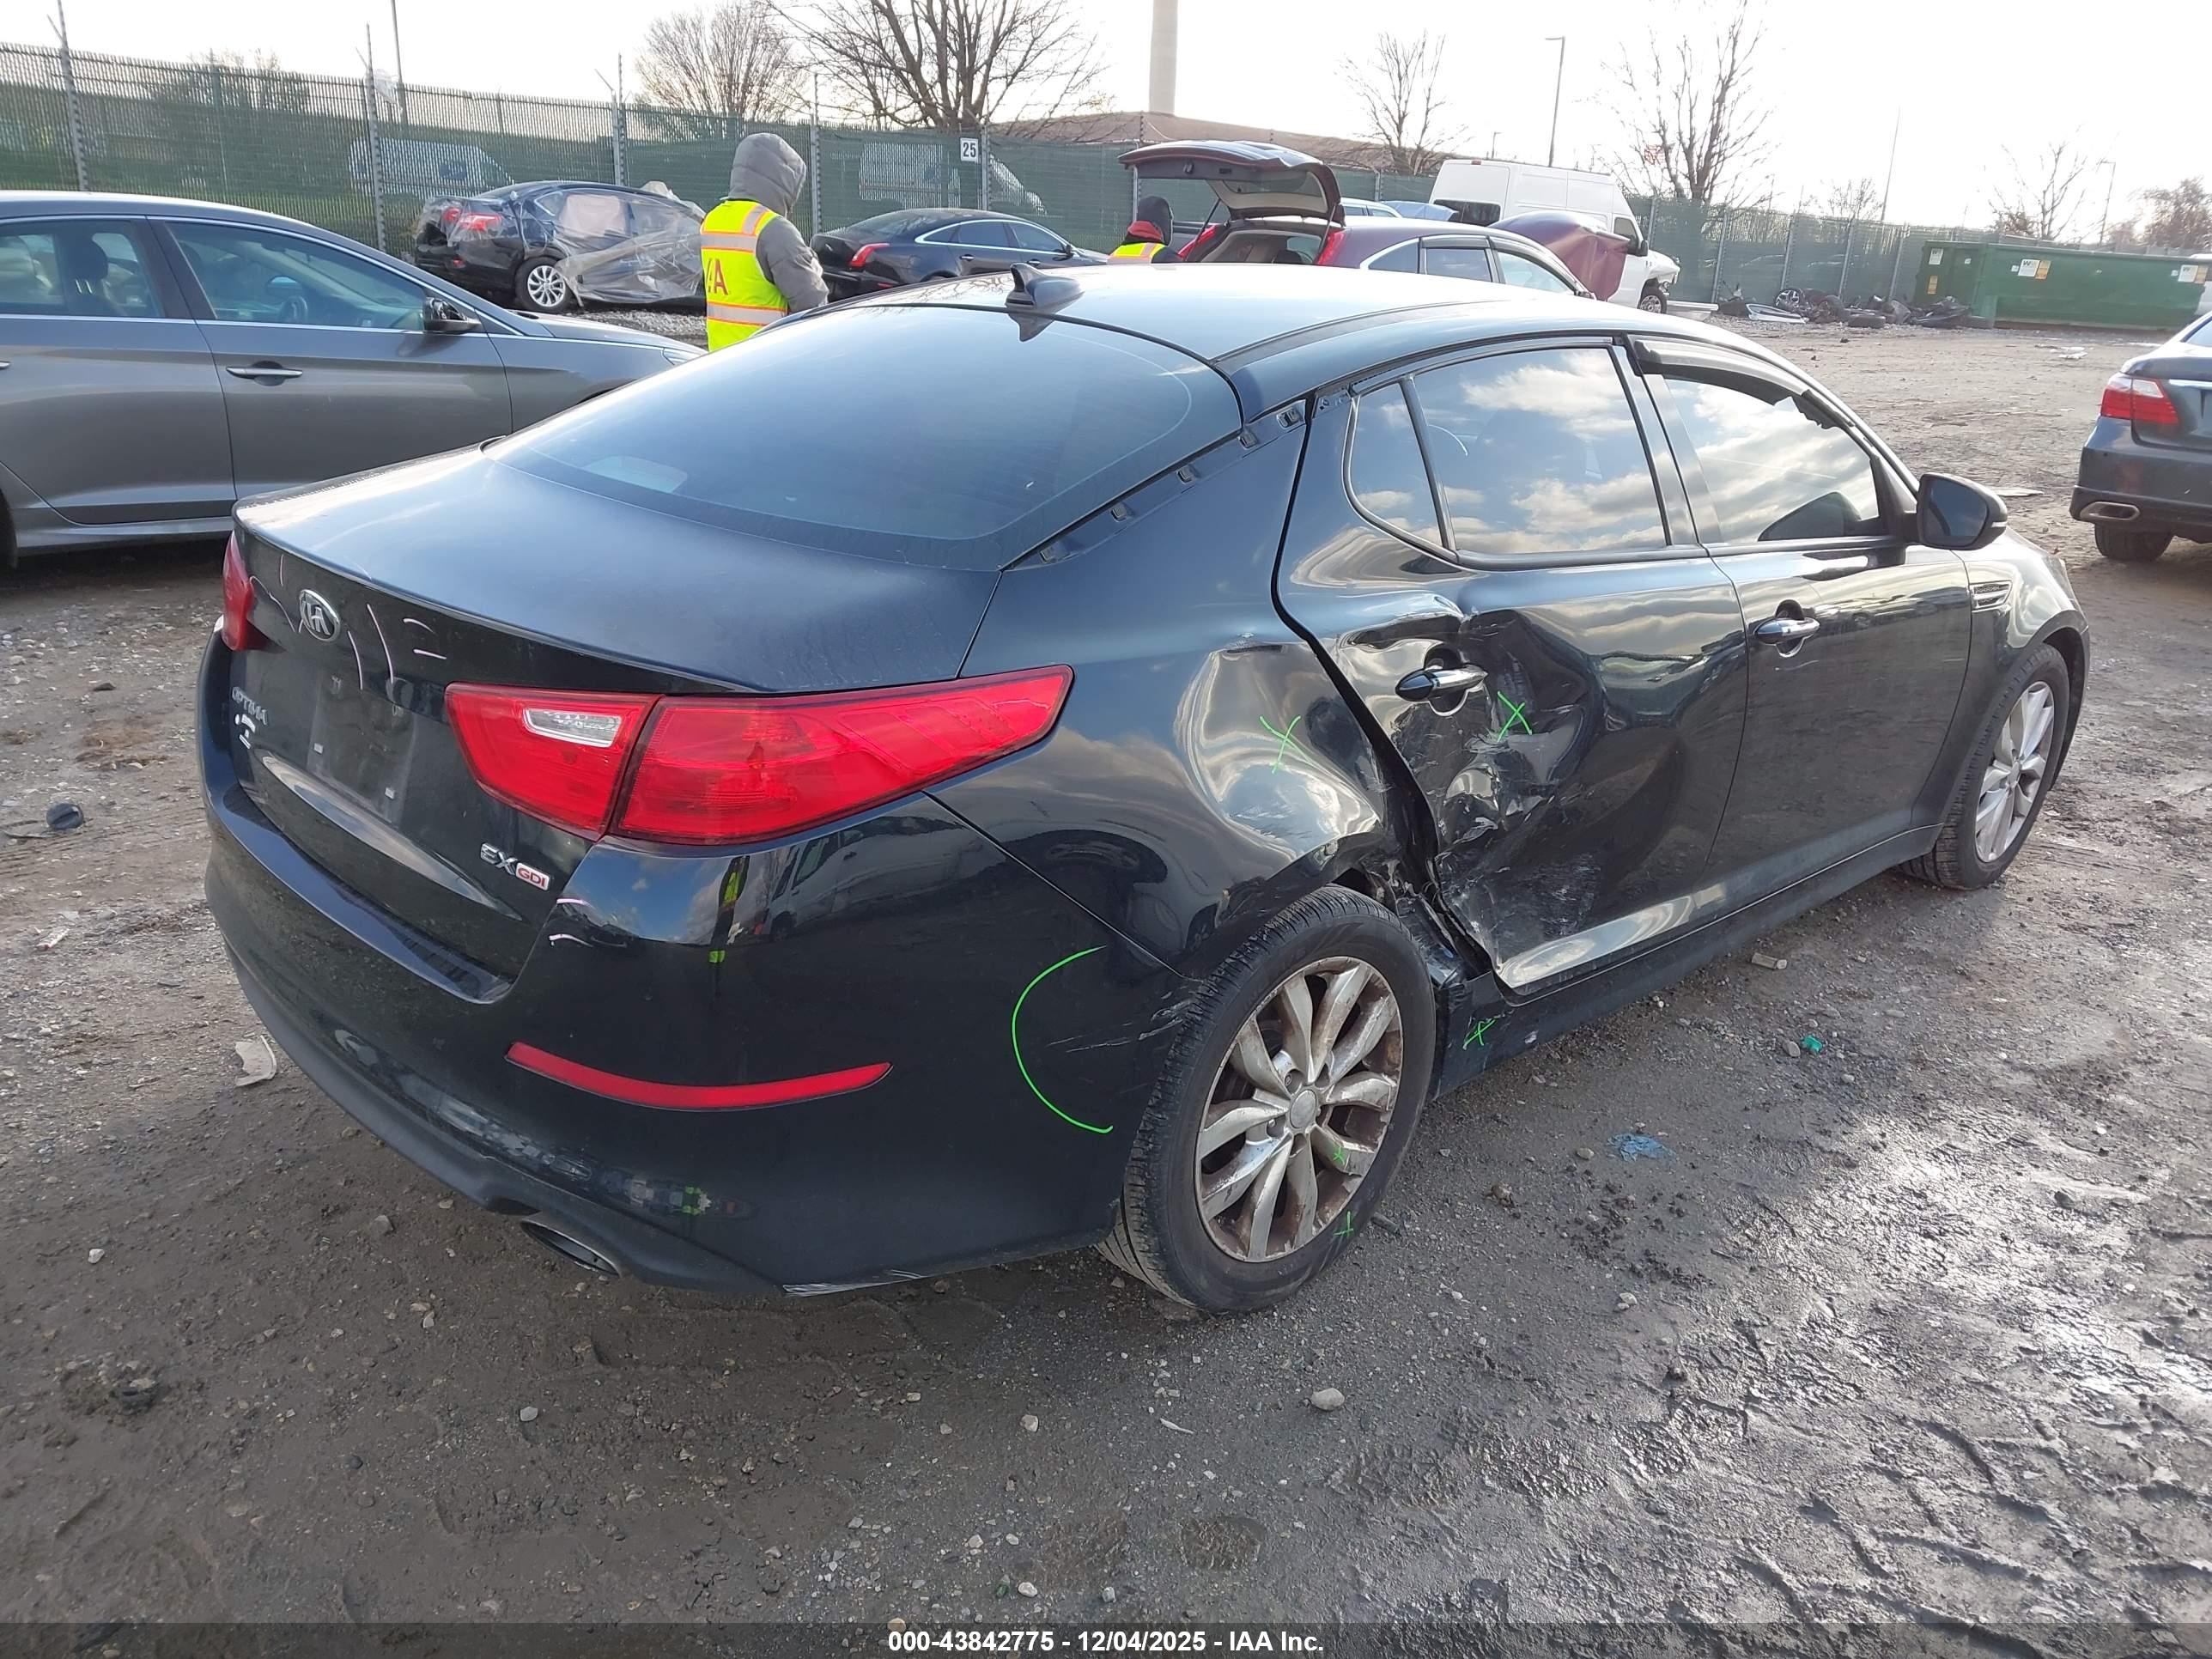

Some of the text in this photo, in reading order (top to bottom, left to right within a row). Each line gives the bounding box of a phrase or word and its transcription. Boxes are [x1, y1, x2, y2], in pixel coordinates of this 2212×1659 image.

[963, 142, 976, 158] 25
[232, 686, 268, 726] OPTIMA
[480, 842, 547, 887] EX GDI
